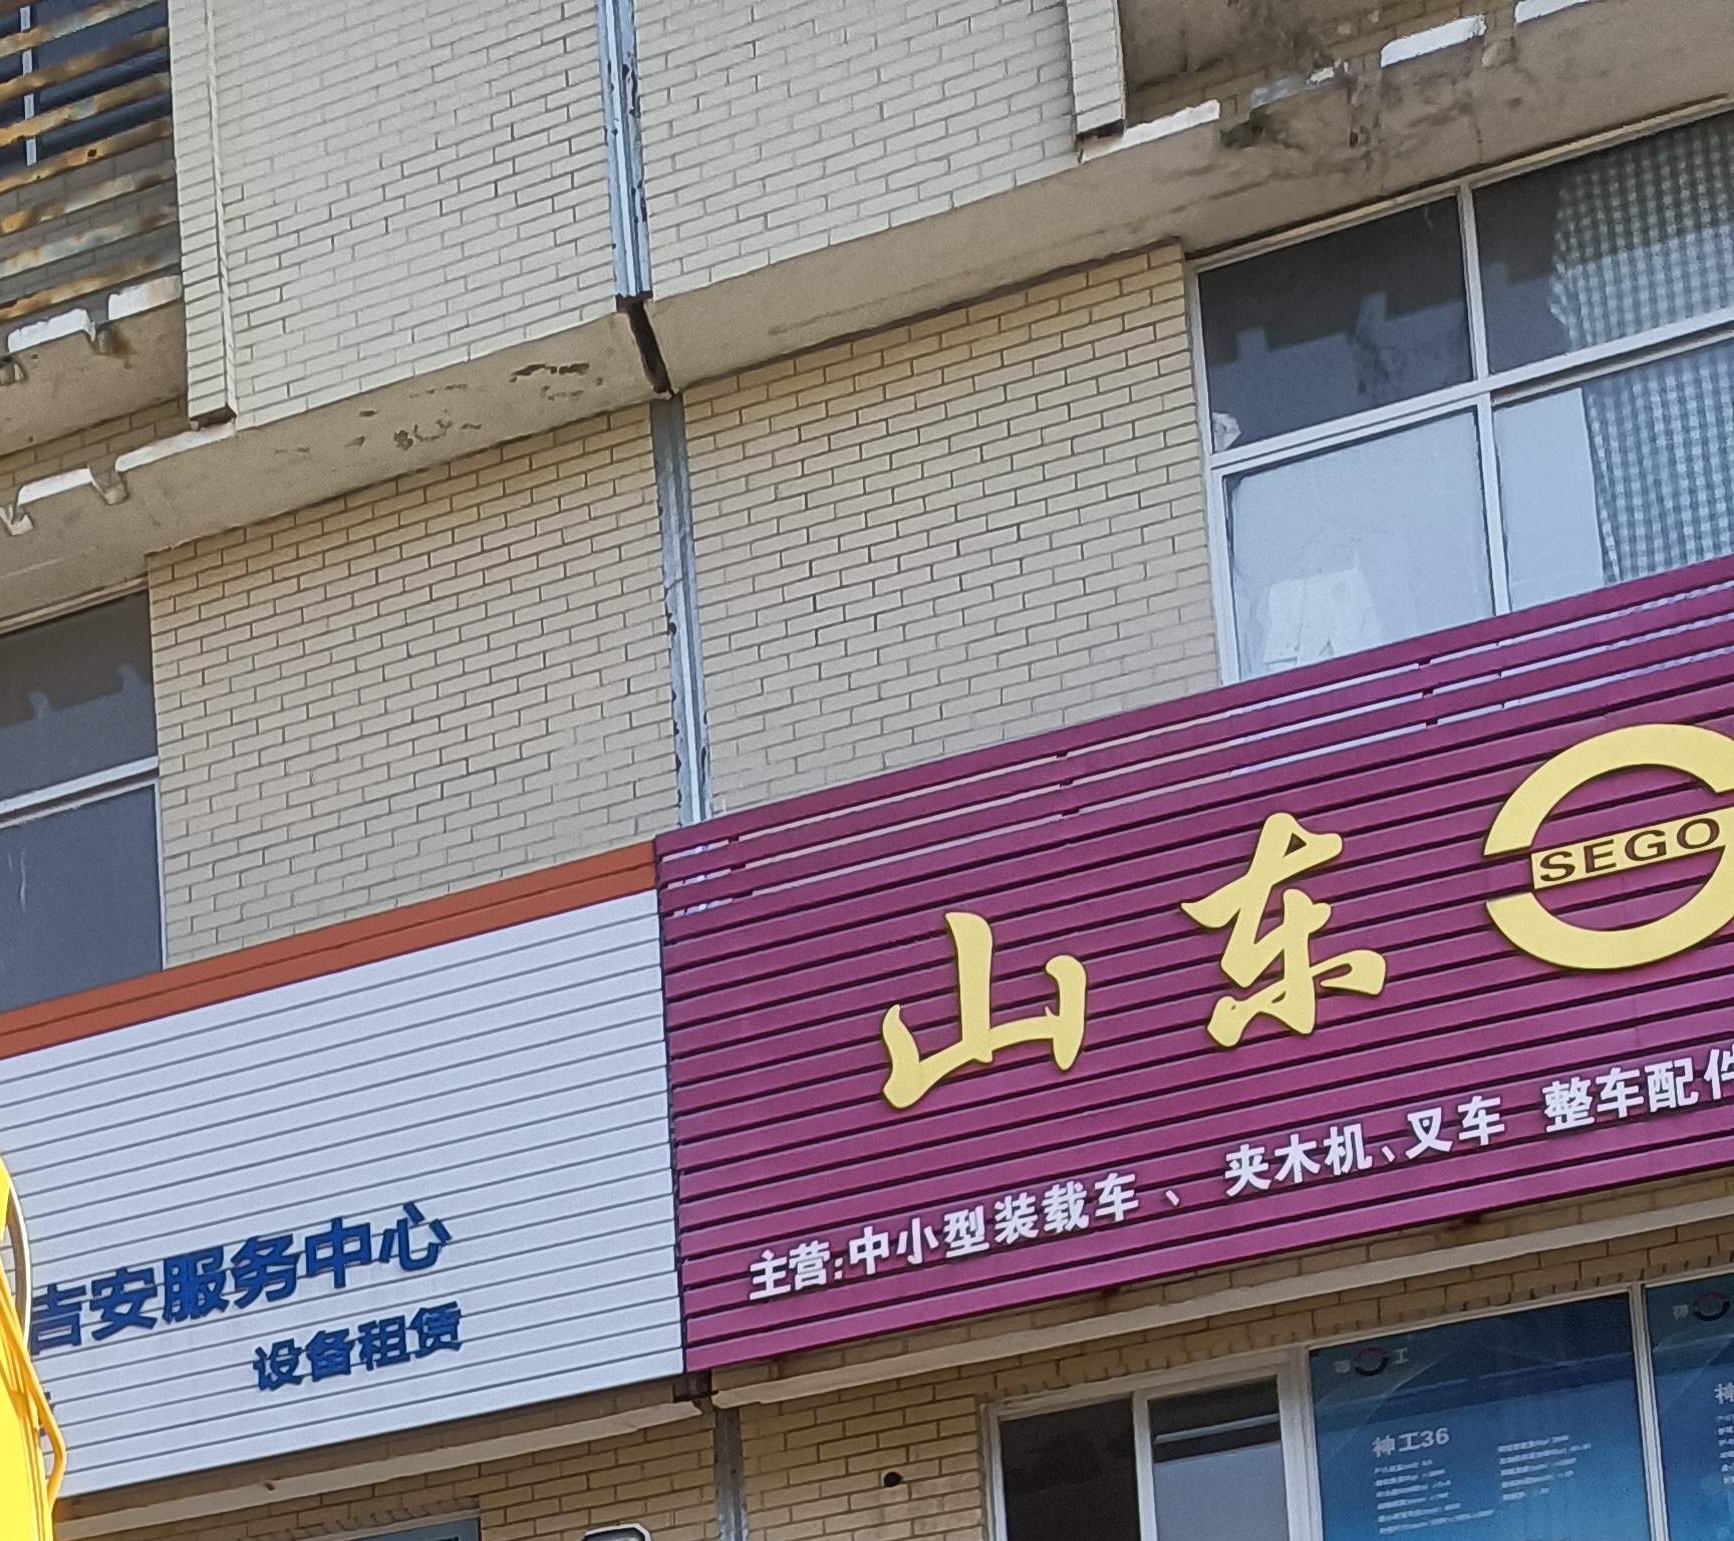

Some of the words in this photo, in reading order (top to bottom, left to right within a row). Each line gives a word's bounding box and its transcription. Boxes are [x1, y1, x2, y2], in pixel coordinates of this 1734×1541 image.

[1539, 817, 1721, 882] SEGO
[880, 811, 1387, 1109] 山东
[252, 1302, 463, 1391] 设备租赁
